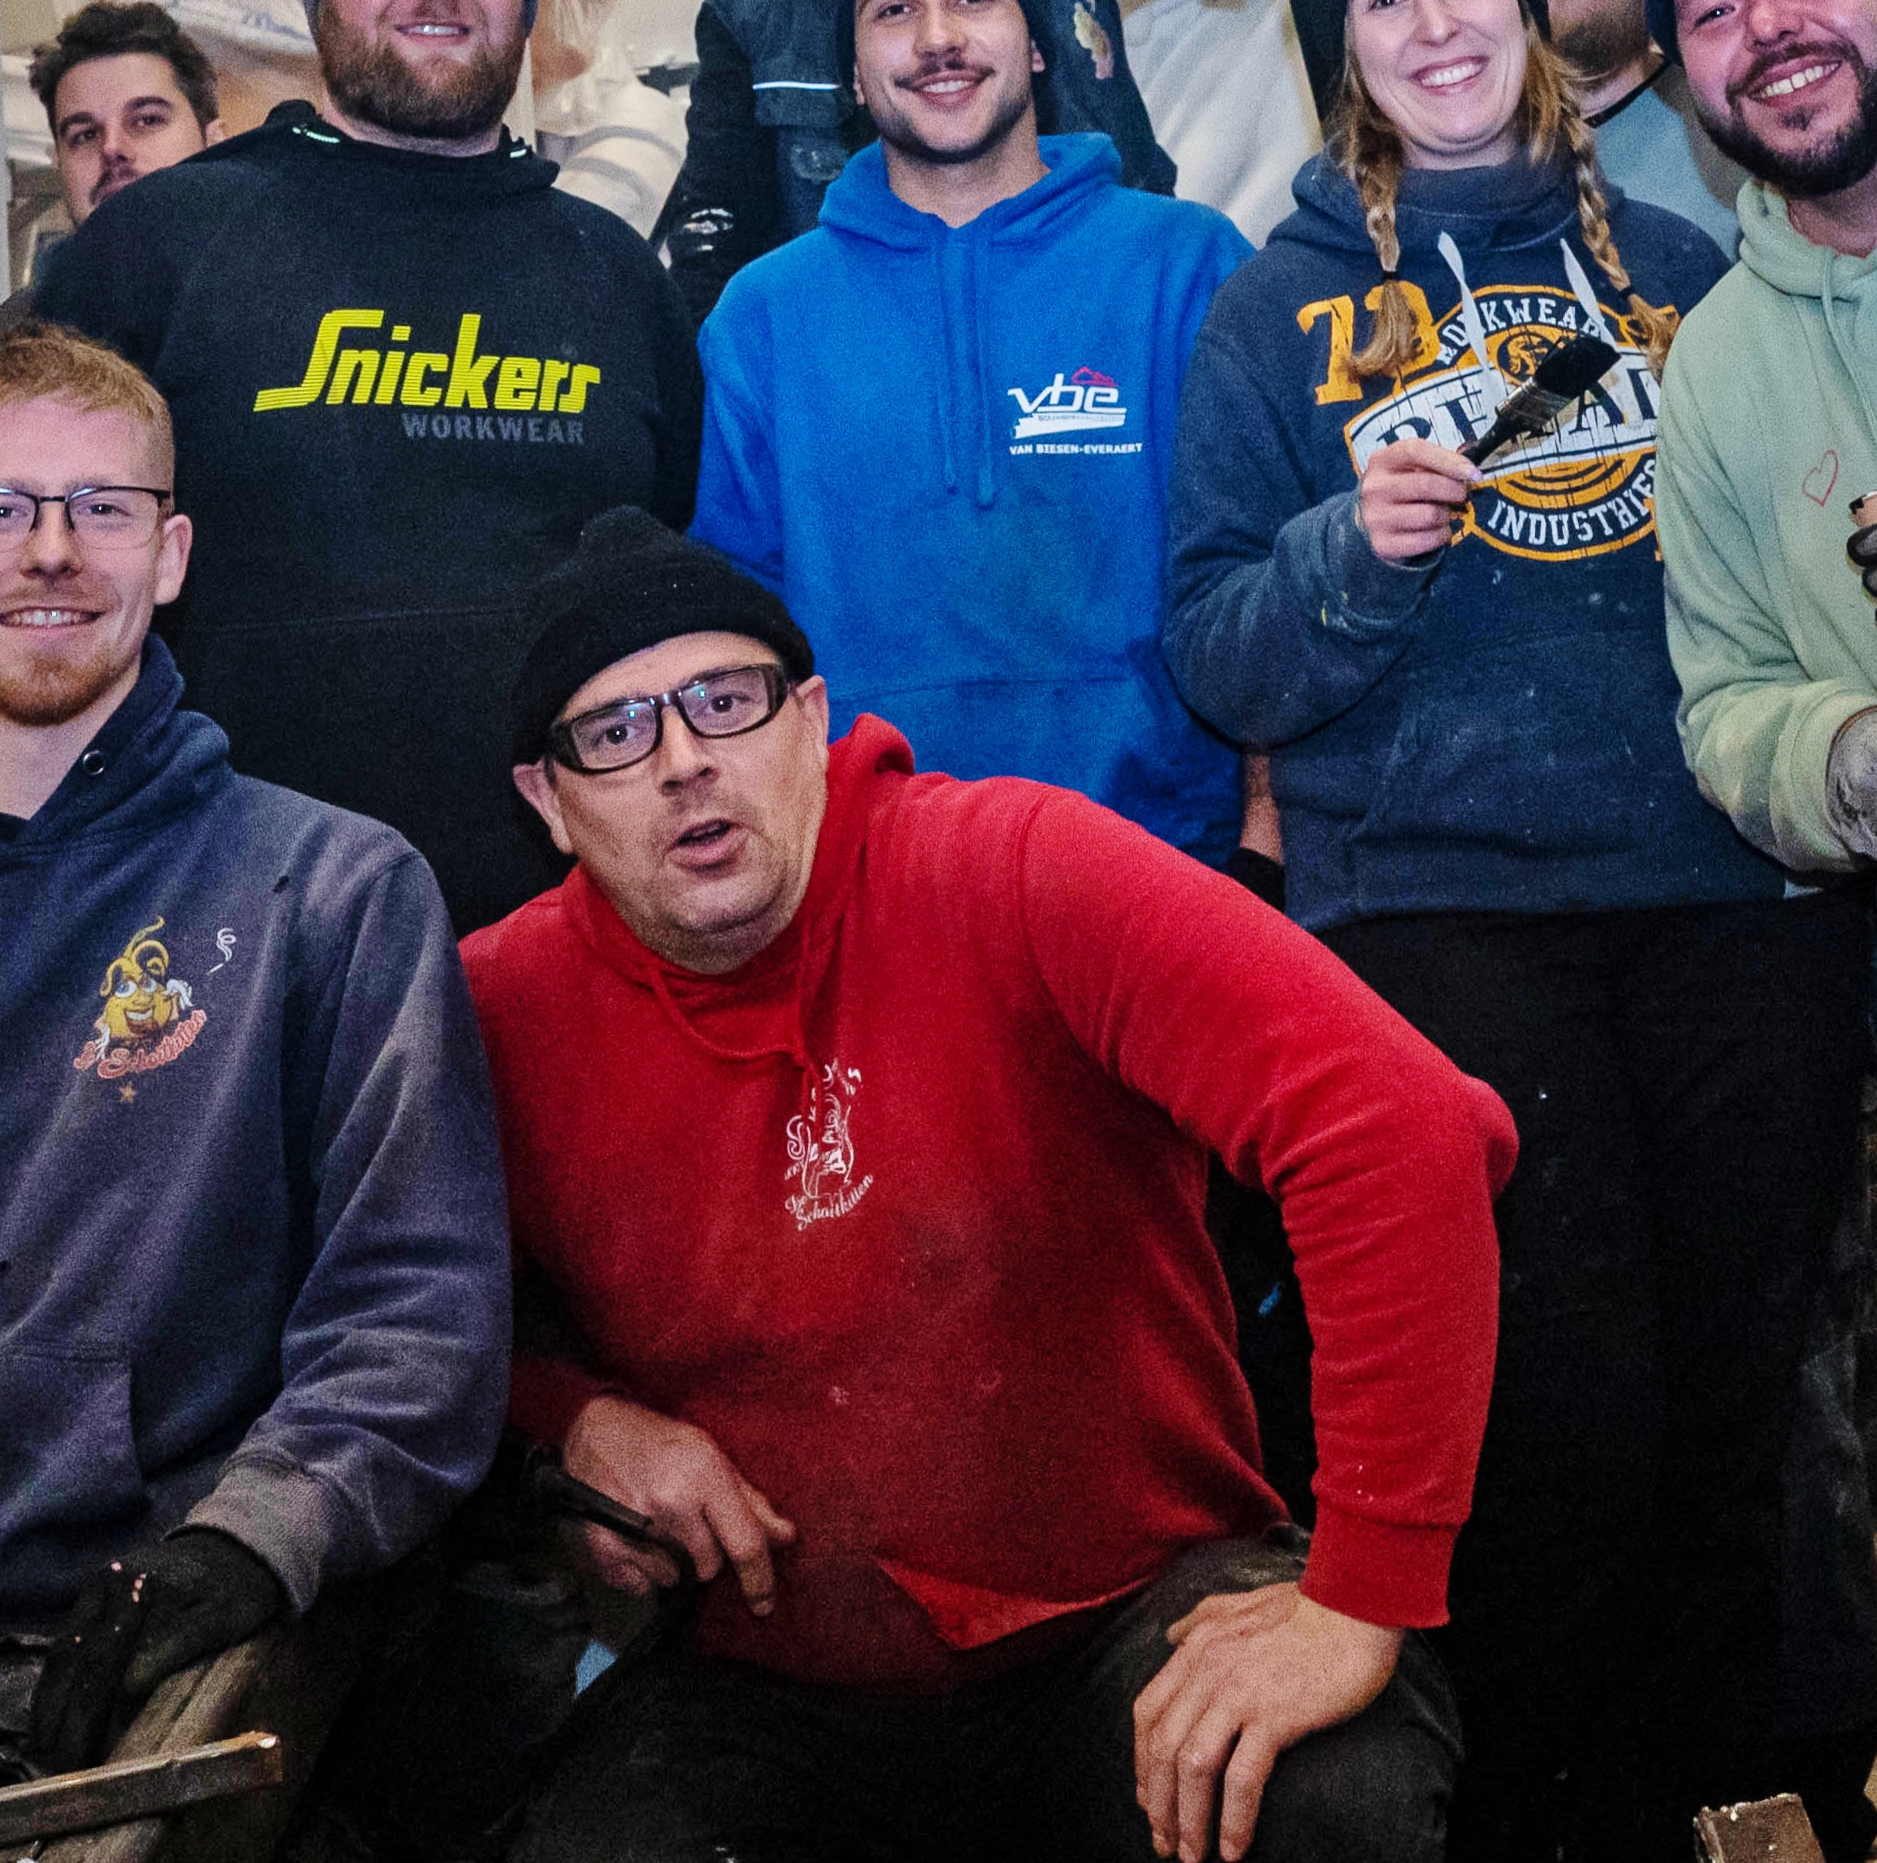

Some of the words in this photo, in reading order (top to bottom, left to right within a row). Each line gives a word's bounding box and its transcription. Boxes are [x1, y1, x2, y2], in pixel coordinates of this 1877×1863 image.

[253, 309, 602, 414] Snickers
[400, 412, 586, 444] WORKWEAR
[1009, 444, 1033, 455] VAN
[1036, 442, 1143, 455] BIESEN-EVERAERT
